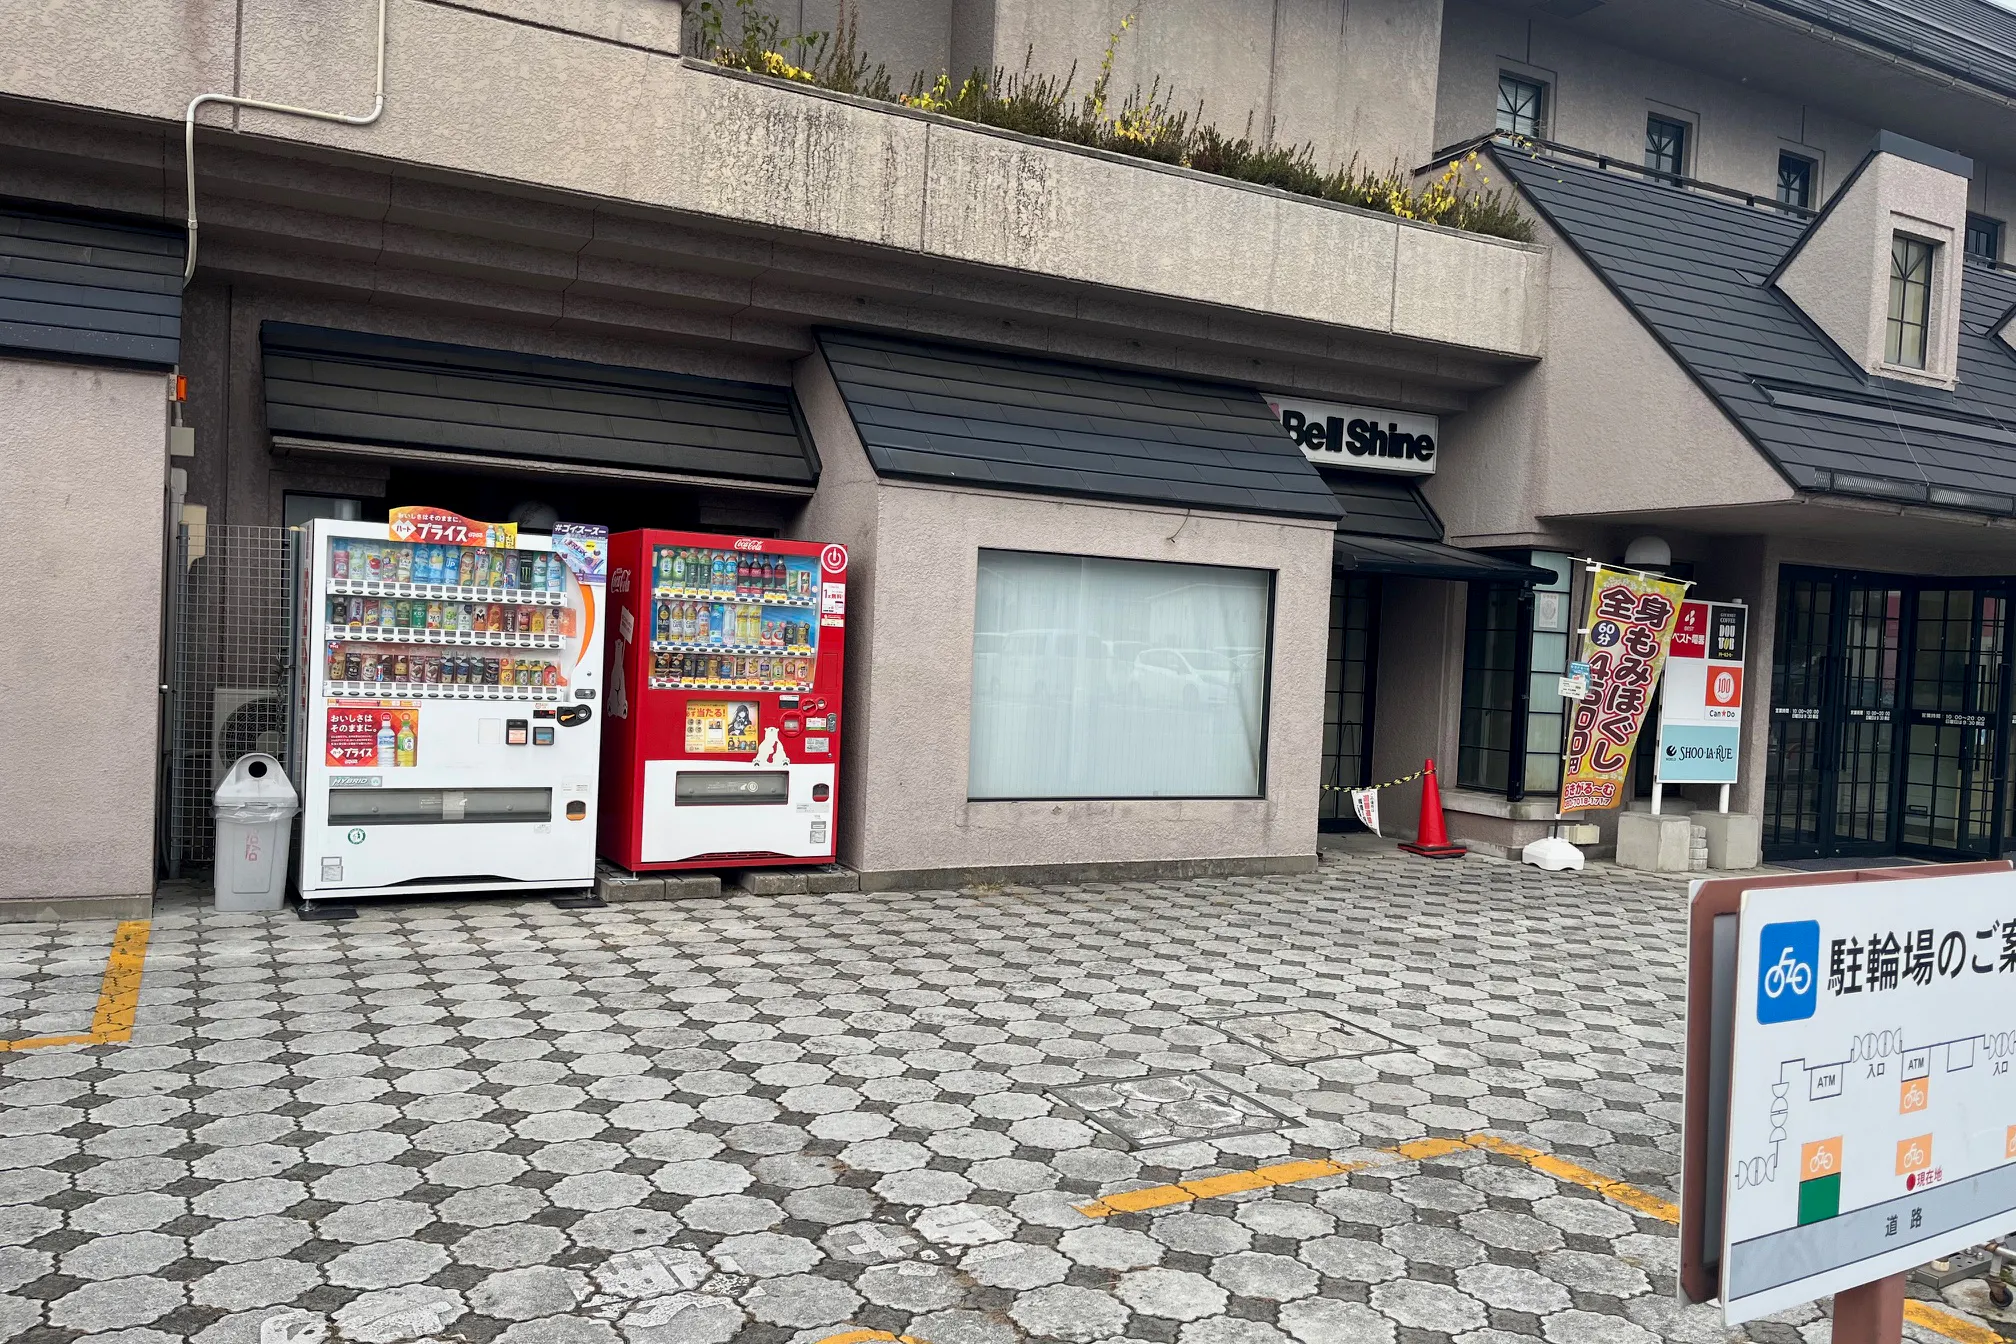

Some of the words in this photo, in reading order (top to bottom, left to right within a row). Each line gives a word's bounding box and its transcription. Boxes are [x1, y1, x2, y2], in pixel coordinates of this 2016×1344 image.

[1283, 410, 1344, 453] Bell
[1346, 418, 1435, 462] Shine
[417, 523, 467, 543] プライス
[734, 539, 764, 551] Coca-Cola
[1598, 588, 1673, 630] 全身
[1598, 623, 1615, 635] 60
[1596, 633, 1611, 646] 分
[1717, 678, 1731, 694] 100
[1592, 625, 1659, 771] もみほぐし
[331, 714, 373, 723] おいしさは
[330, 724, 377, 733] そのままに。
[344, 748, 373, 757] プライス
[1866, 1062, 1885, 1079] 入口
[1908, 1056, 1925, 1071] ATM
[1992, 1060, 2009, 1077] 入口
[1817, 1074, 1836, 1089] ATM
[1916, 1165, 1943, 1188] 現在地
